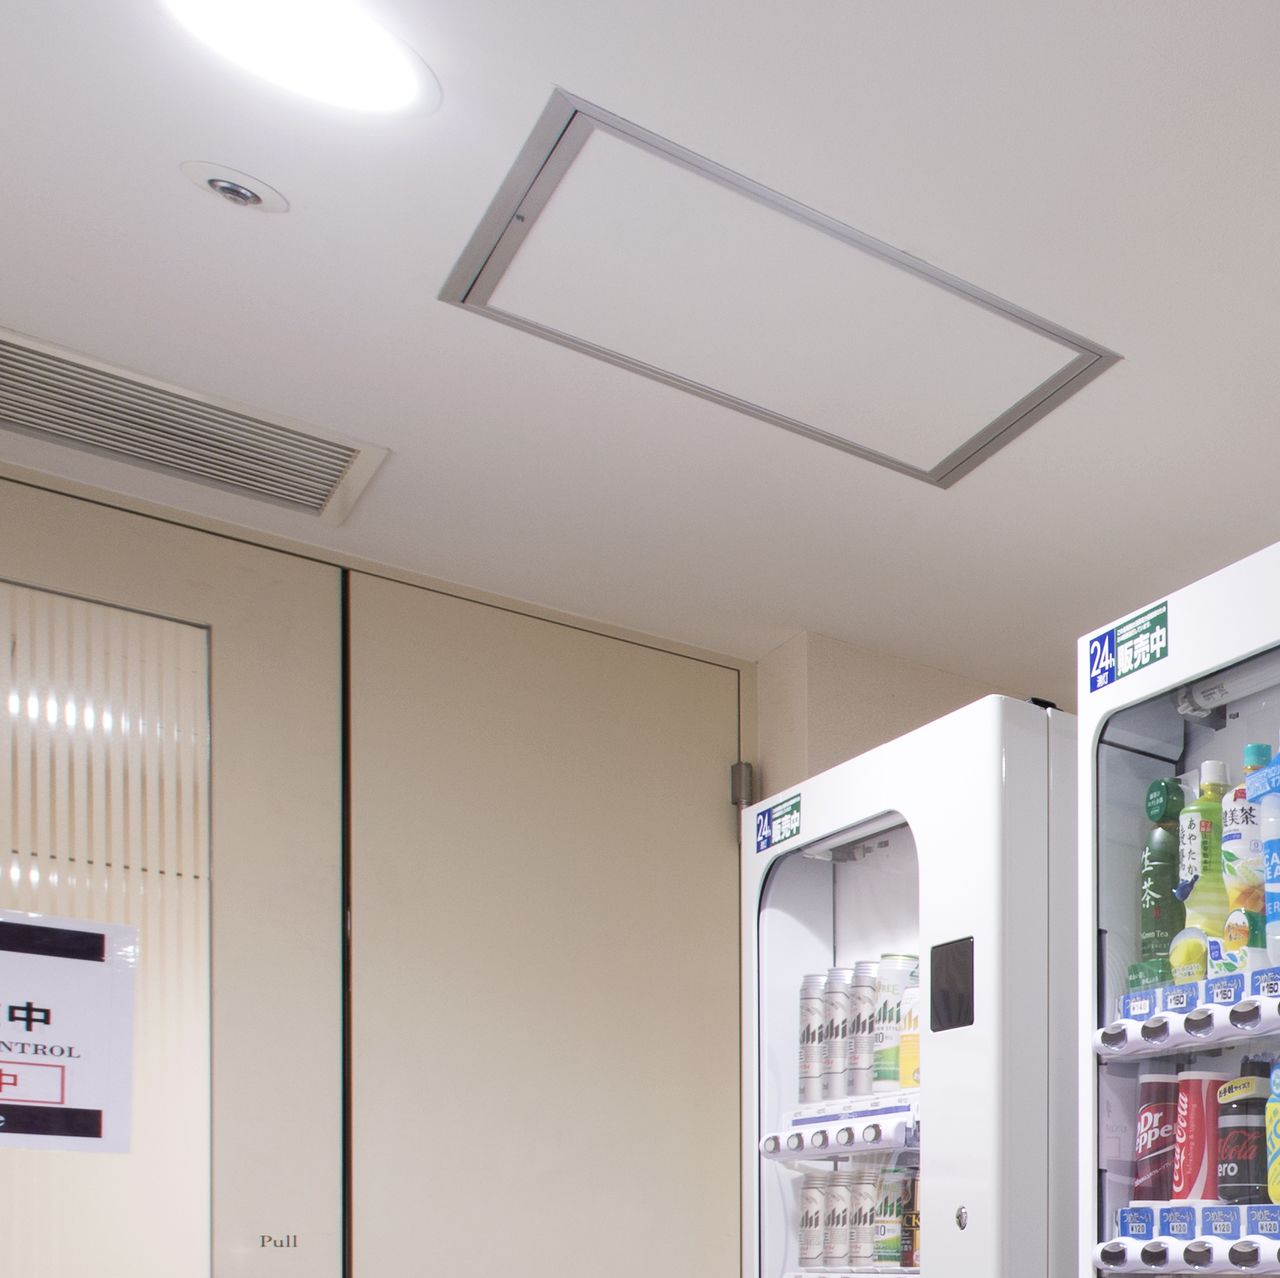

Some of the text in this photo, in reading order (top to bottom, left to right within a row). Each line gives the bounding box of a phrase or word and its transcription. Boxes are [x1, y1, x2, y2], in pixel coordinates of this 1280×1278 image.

[1118, 625, 1166, 676] 販売中
[1141, 847, 1161, 908] 生茶
[8, 1001, 51, 1032] 中
[1140, 1111, 1163, 1134] Dr
[1214, 1223, 1230, 1233] ¥120
[1260, 1222, 1277, 1233] ¥120
[259, 1234, 298, 1248] Pull
